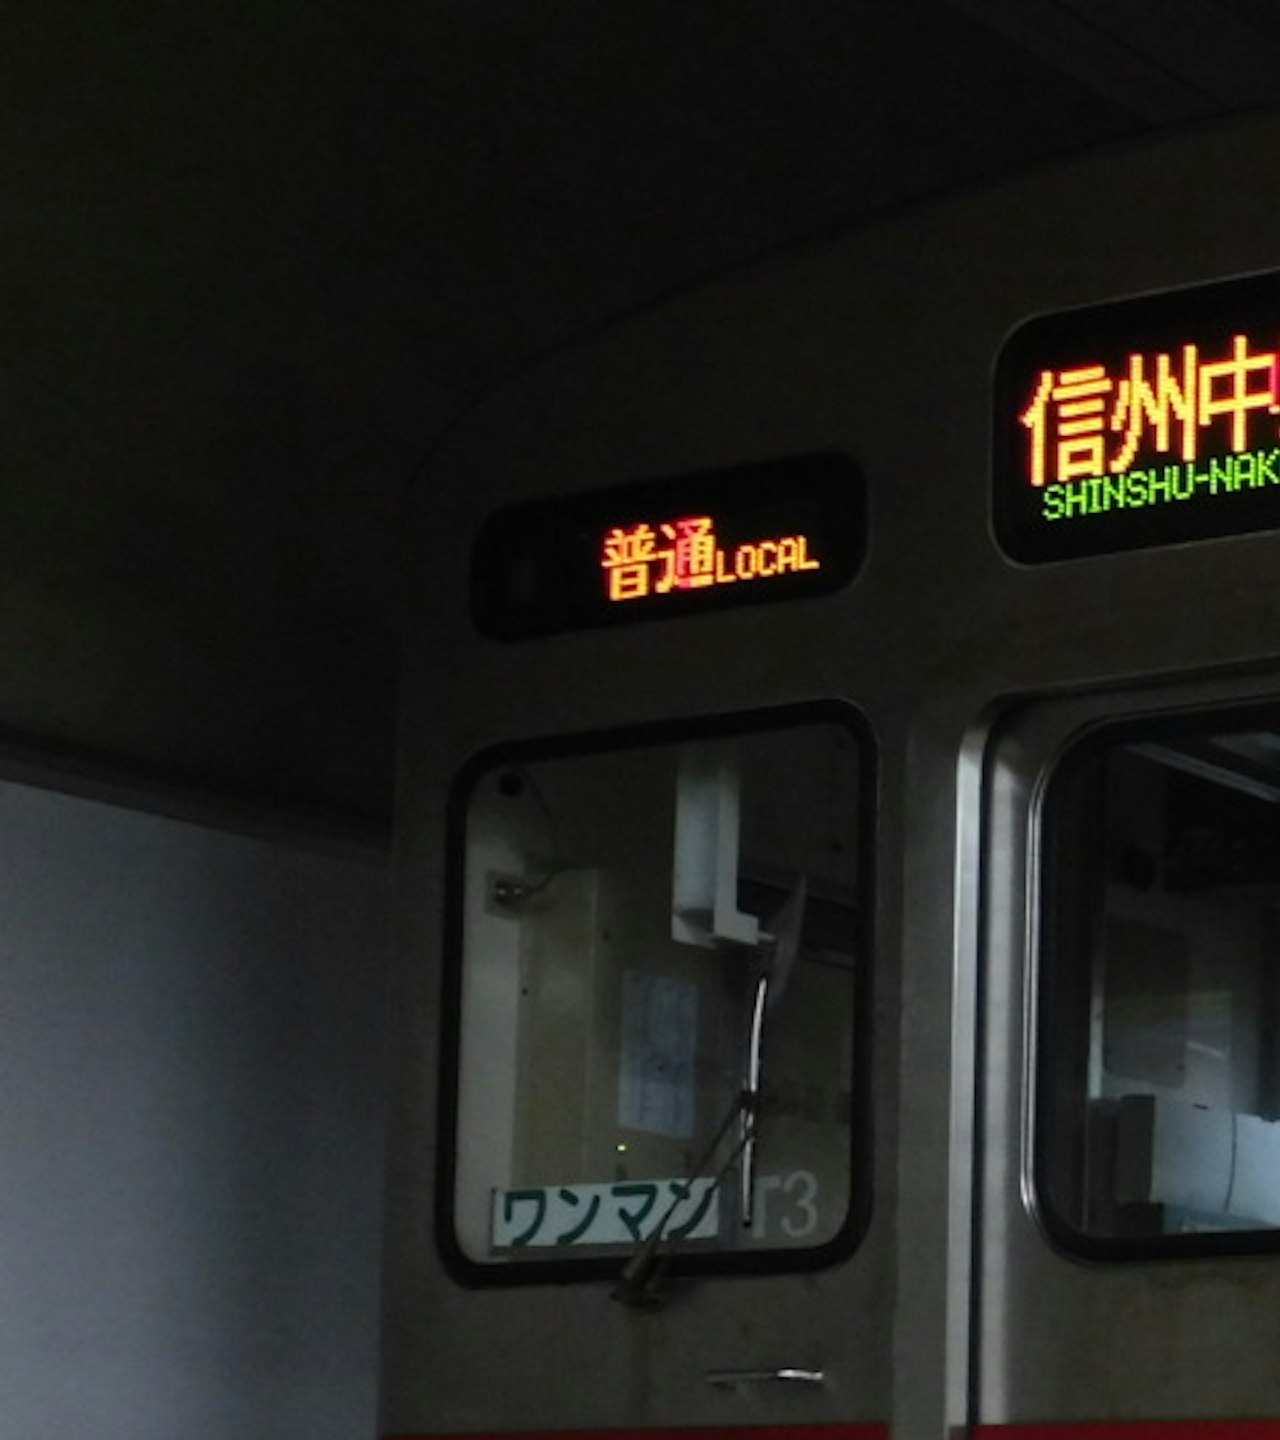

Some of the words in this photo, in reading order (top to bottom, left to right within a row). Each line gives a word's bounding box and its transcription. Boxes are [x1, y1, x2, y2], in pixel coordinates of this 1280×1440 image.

[600, 516, 714, 601] 普通
[716, 534, 819, 583] LOCAL
[504, 1182, 715, 1248] ワンマン
